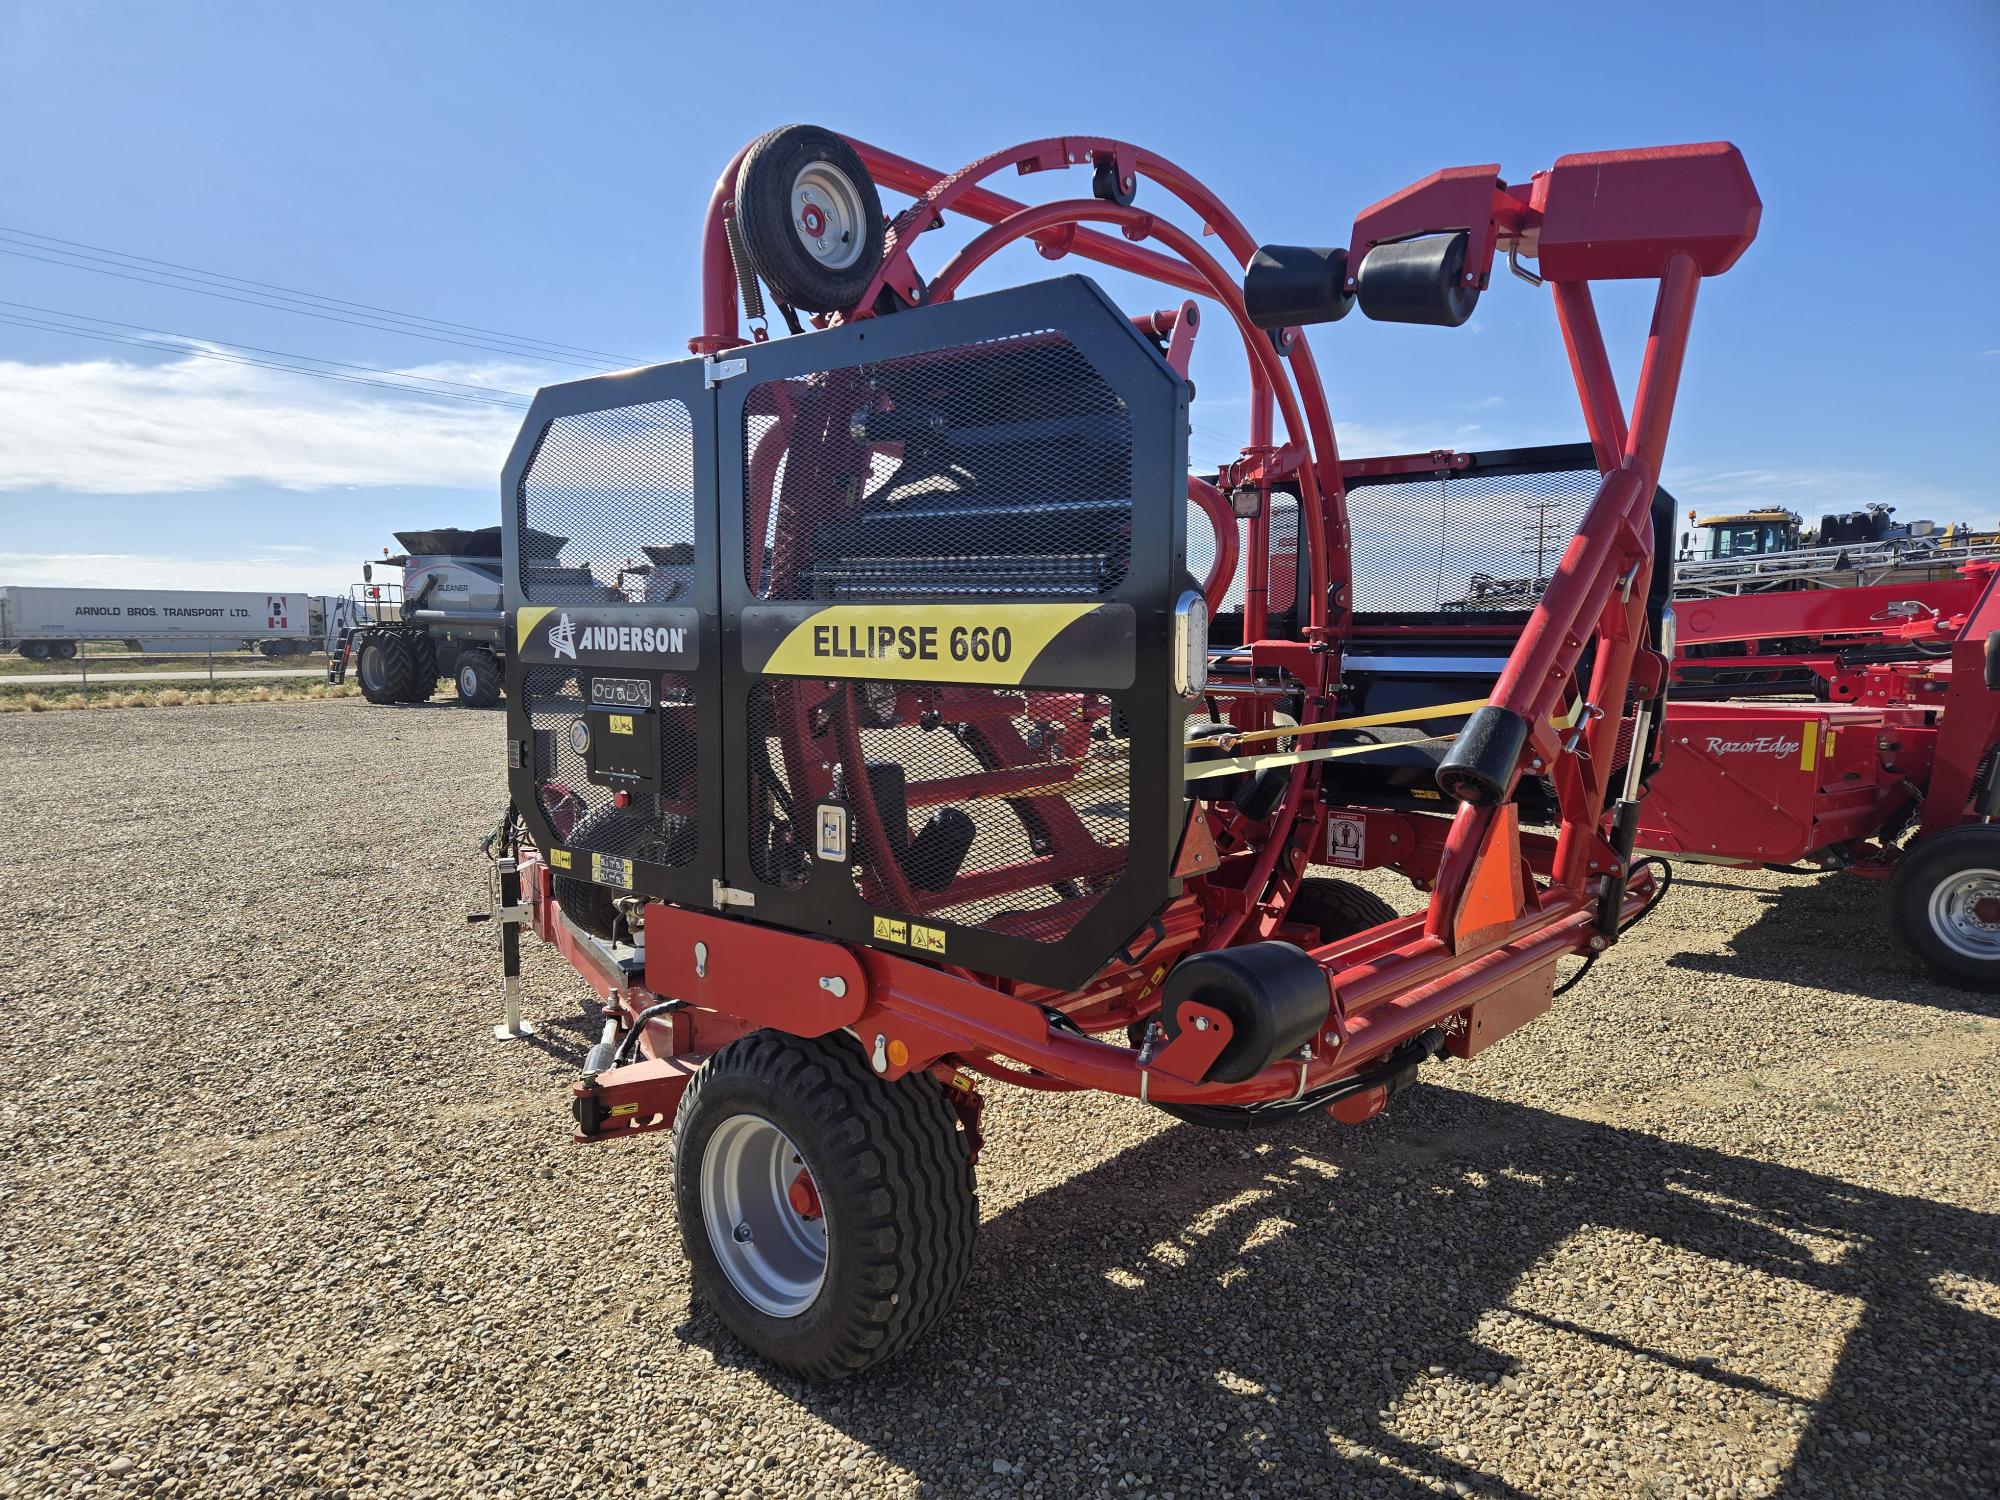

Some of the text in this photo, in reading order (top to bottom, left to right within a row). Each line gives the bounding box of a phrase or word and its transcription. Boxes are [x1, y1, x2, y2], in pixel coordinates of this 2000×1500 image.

[437, 584, 469, 593] GLEANER
[75, 606, 251, 617] ARNOLD BROS. TRANSPORT LTD.
[578, 626, 684, 653] ANDERSON
[813, 625, 1012, 662] ELLIPSE 660
[1705, 735, 1800, 759] RazorEdge
